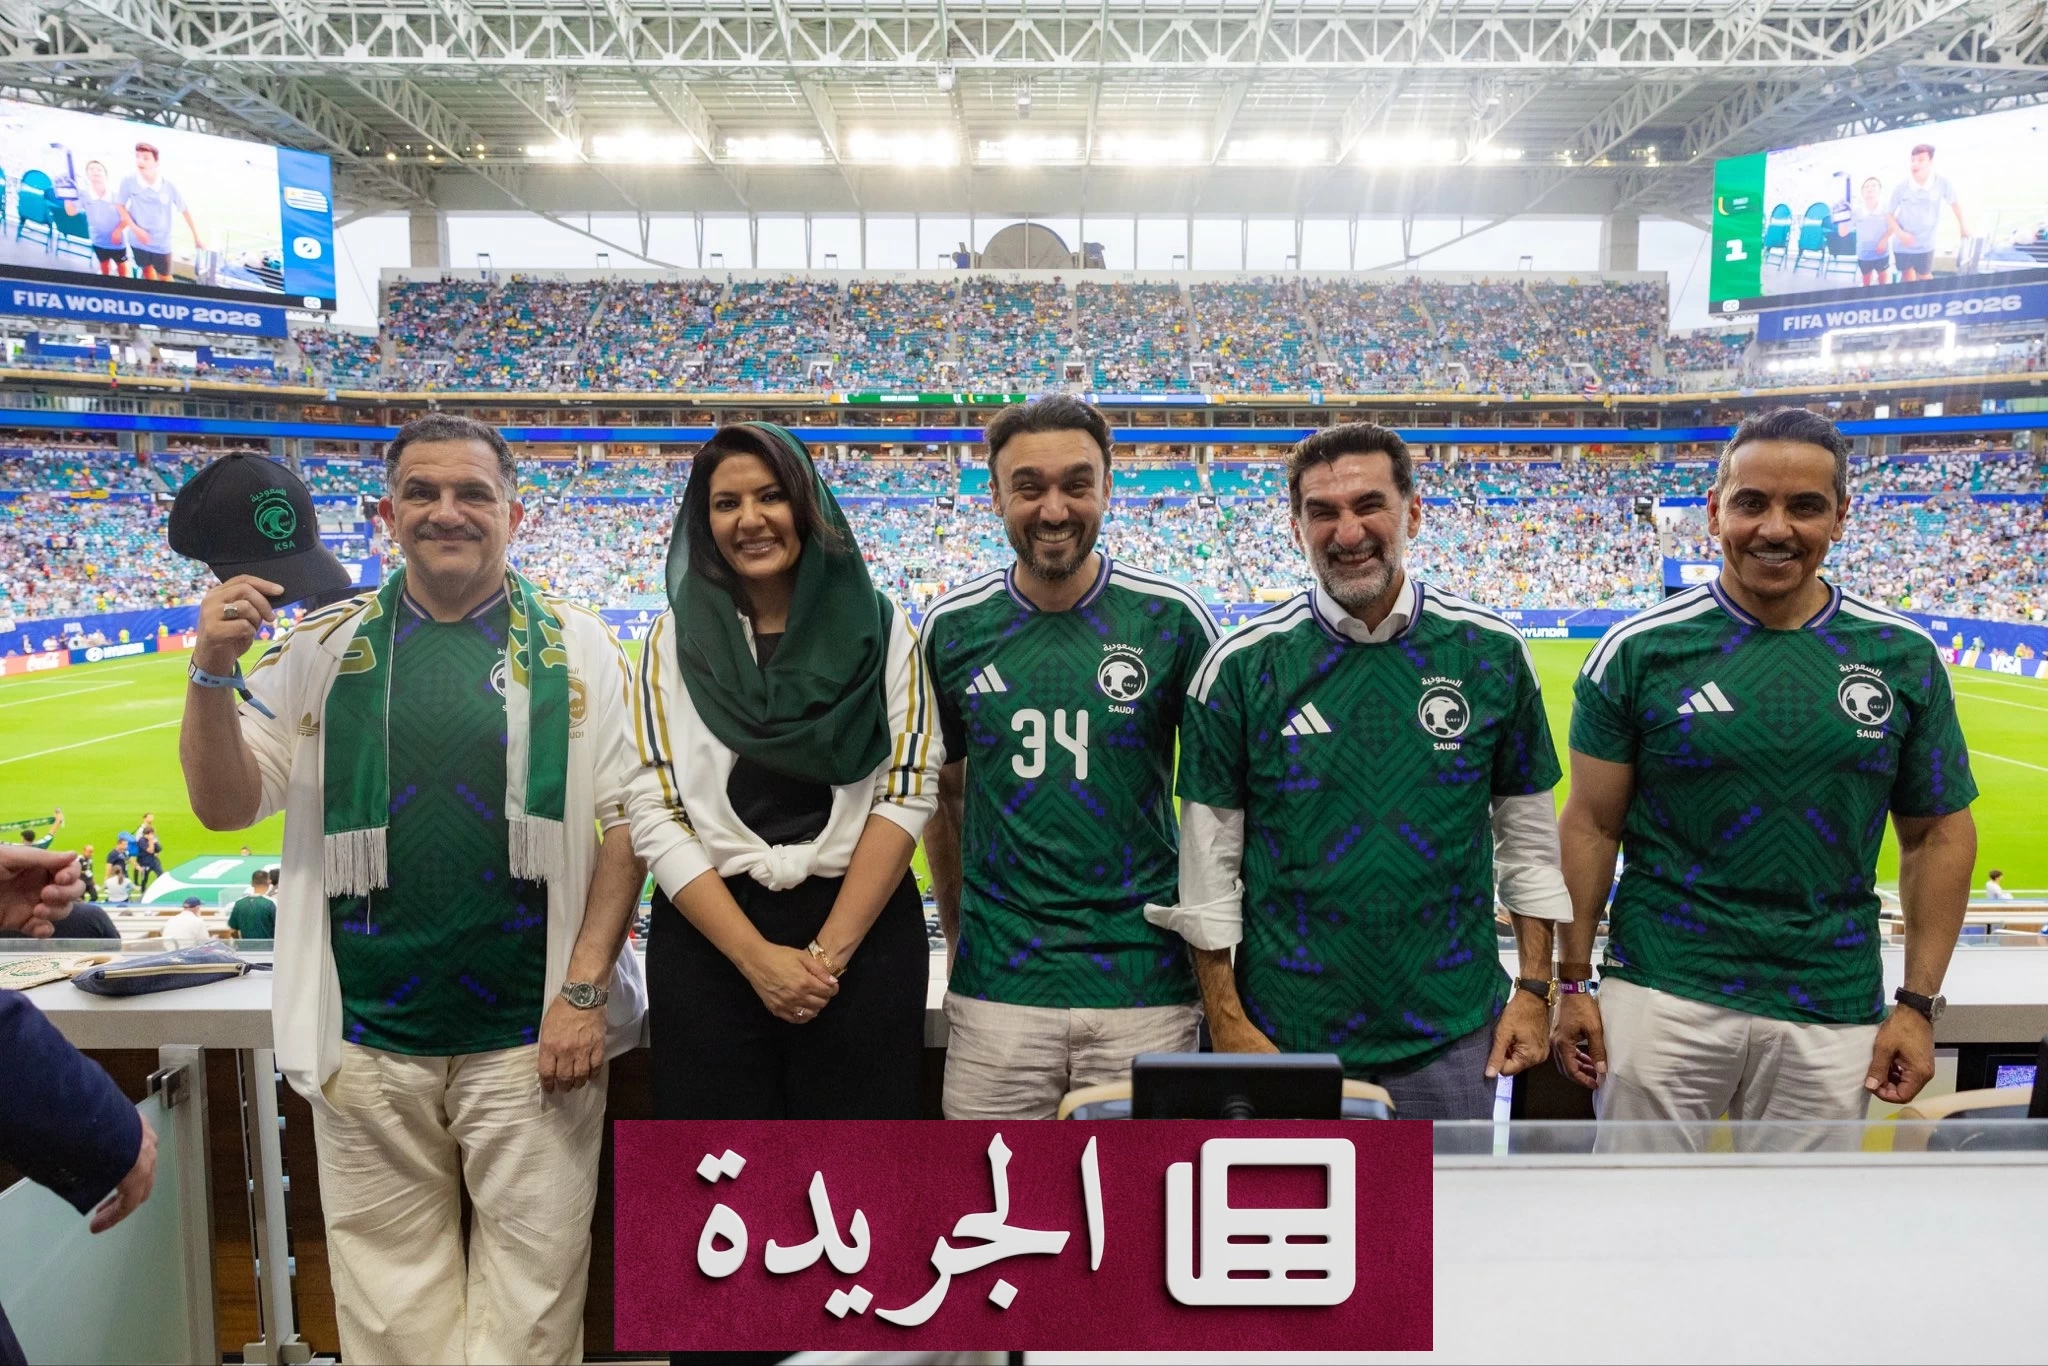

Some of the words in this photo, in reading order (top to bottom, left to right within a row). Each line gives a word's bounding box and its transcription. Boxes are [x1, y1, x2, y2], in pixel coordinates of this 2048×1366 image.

[293, 236, 322, 260] 0
[1725, 239, 1748, 262] 1
[13, 290, 63, 310] FIFA
[65, 295, 145, 317] WORLD
[148, 303, 190, 321] CUP
[192, 308, 262, 328] 2026
[1783, 316, 1824, 331] FIFA
[1827, 310, 1898, 327] WORLD
[1900, 304, 1943, 320] CUP
[1945, 295, 2022, 317] 2026
[274, 540, 296, 552] KSA
[1501, 611, 1523, 620] FIFA
[1102, 643, 1144, 655] السعودية
[1838, 663, 1883, 677] السعودية
[1988, 653, 2022, 675] VISA
[1421, 676, 1463, 688] السعودية
[1108, 704, 1135, 714] SAUDI
[569, 731, 584, 739] UDI
[1856, 729, 1884, 739] SAUDI
[1011, 708, 1089, 780] 34
[1433, 742, 1461, 750] SAUDI
